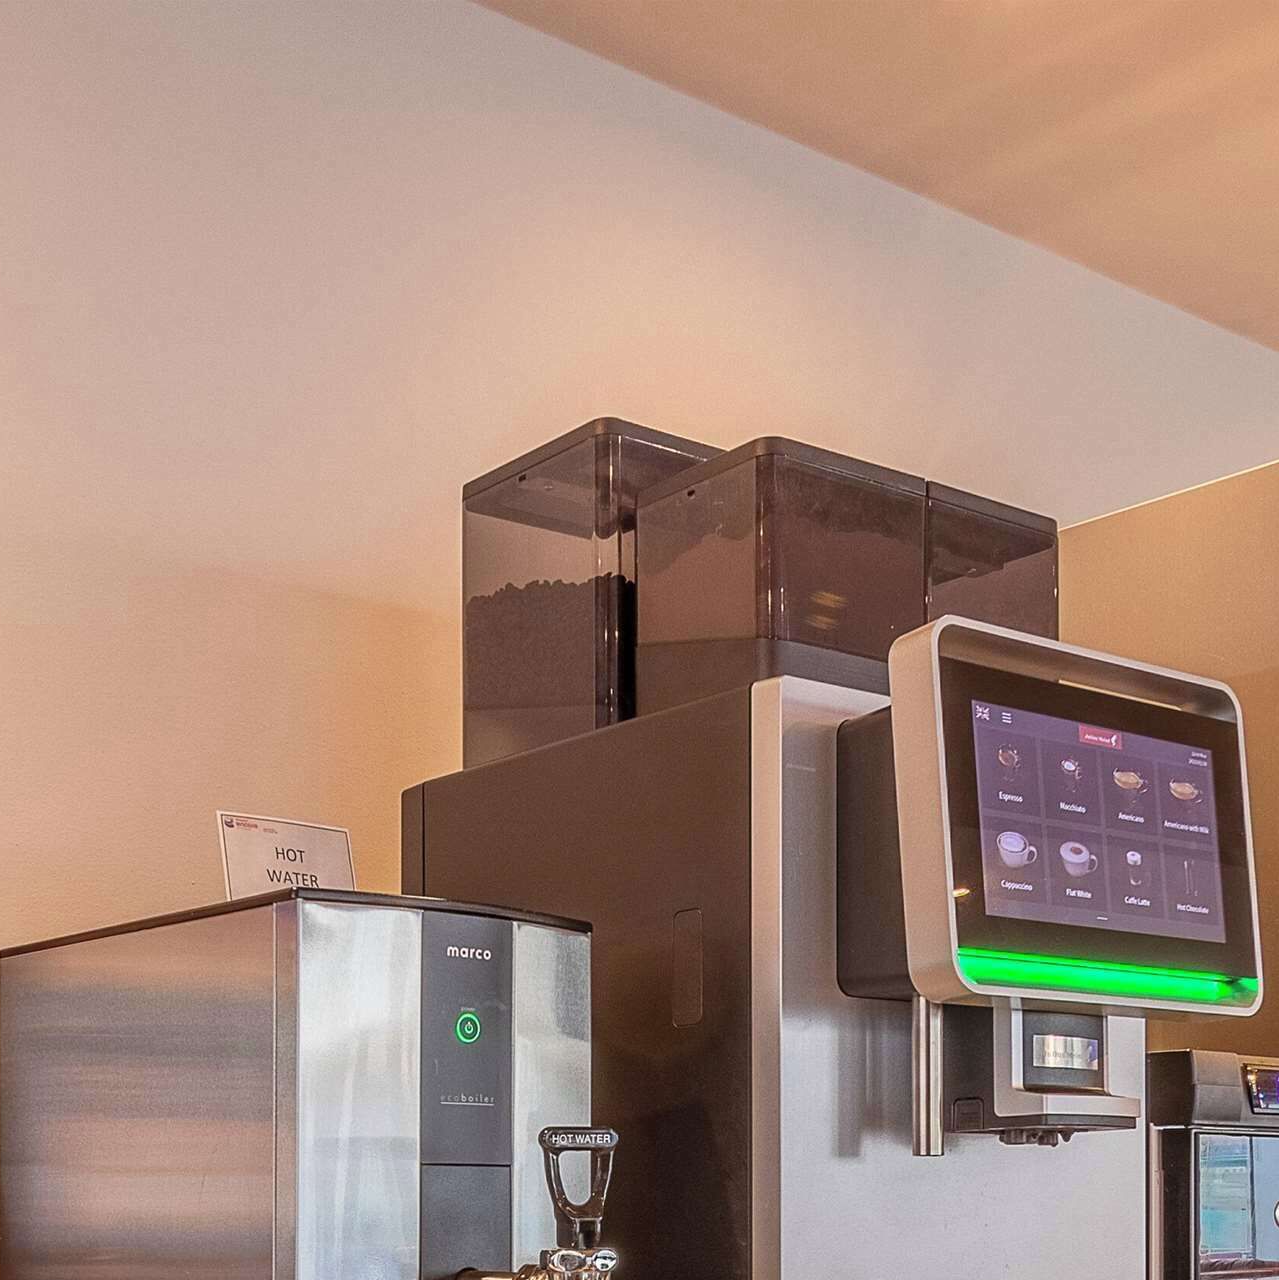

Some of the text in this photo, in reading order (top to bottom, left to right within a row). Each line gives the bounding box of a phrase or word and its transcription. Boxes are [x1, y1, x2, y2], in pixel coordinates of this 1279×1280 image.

[999, 791, 1023, 803] Espresso
[275, 847, 306, 864] HOT
[266, 868, 320, 888] WATER
[446, 944, 492, 961] marco
[552, 1133, 611, 1144] HOT WATER
